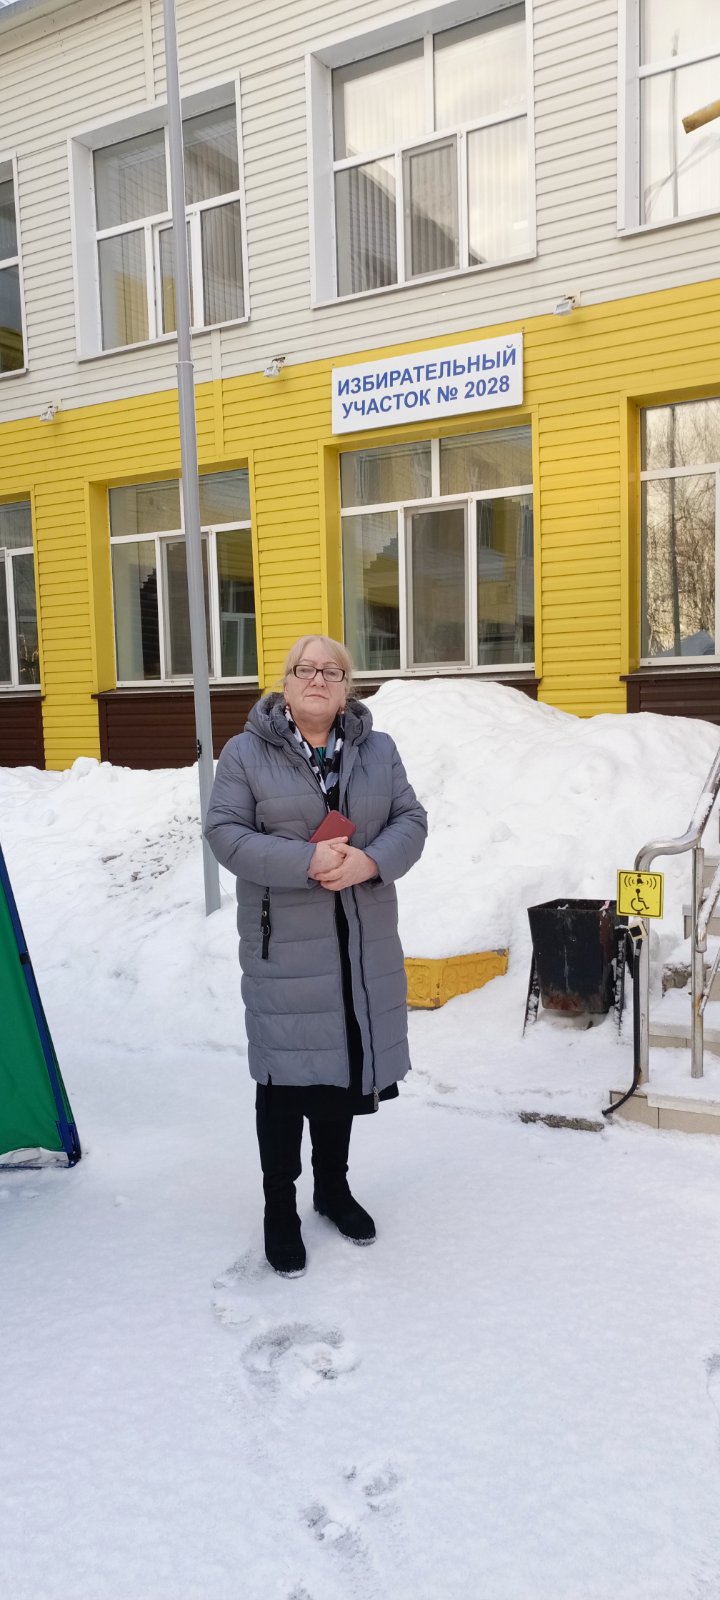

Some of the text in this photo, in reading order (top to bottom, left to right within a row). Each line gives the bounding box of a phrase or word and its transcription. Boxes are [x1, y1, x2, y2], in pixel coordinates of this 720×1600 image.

[338, 344, 516, 396] ИЗБИРАТЕЛЬНЫЙ
[342, 375, 510, 419] УЧАСТОК № 2028
